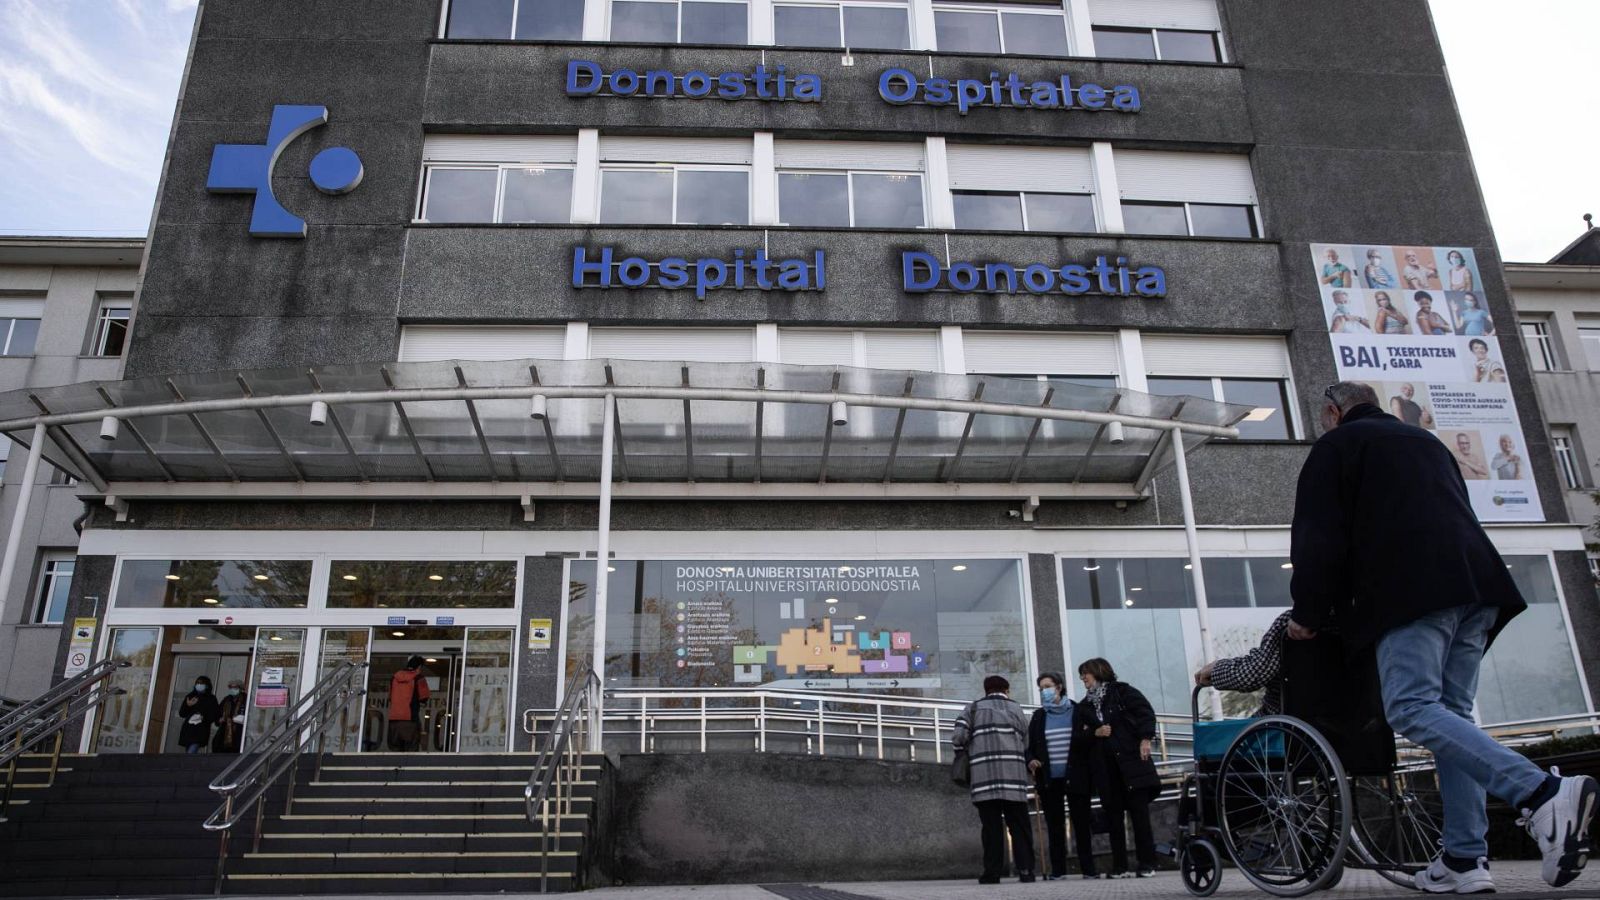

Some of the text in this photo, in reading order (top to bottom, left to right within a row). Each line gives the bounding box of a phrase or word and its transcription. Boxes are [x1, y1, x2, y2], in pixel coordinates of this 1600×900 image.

[567, 60, 1142, 115] Donostia Ospitalea
[572, 246, 1168, 300] Hospital Donostia
[1339, 345, 1456, 371] BAI, TXERTATZEN
[1390, 358, 1422, 368] GARA
[676, 566, 920, 578] DONOSTIA UNIBERTSITATE OSPITALEA
[676, 579, 921, 592] HOSPITAL UNIVERSITARIO DONOSTIA
[915, 656, 922, 666] P
